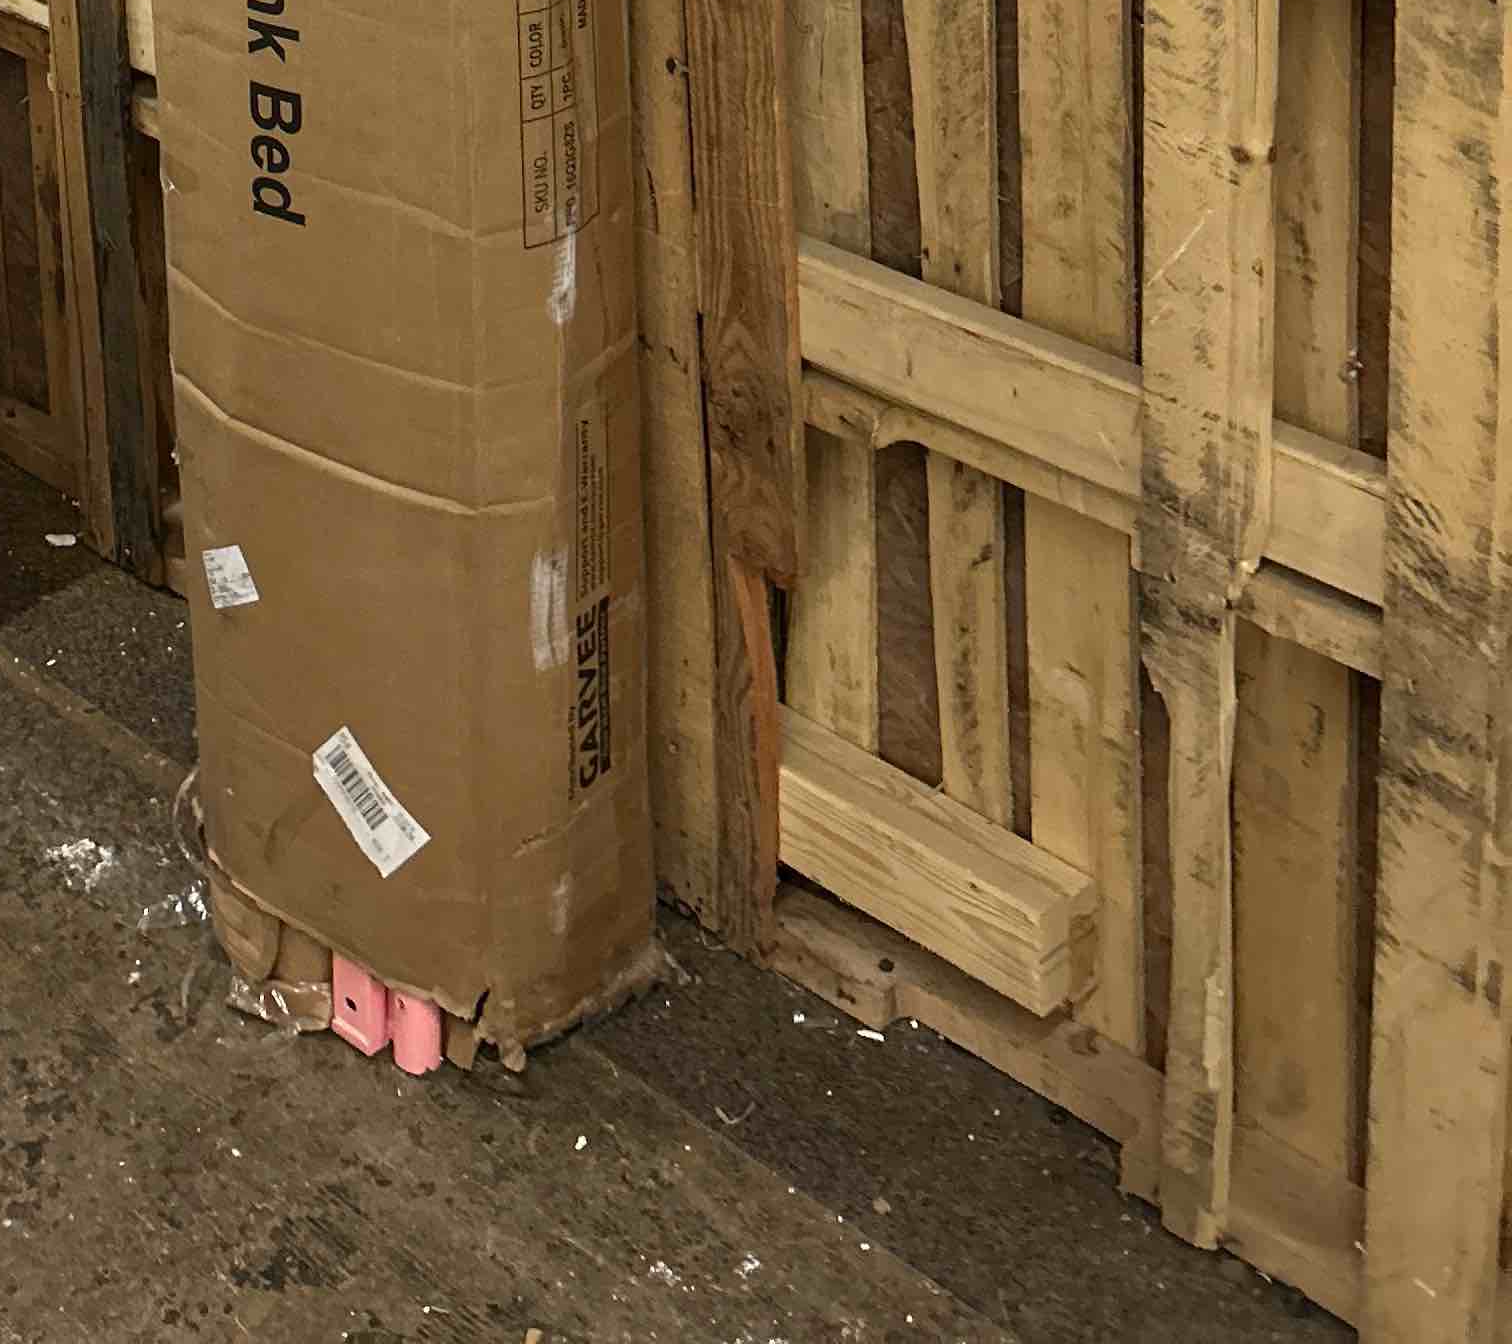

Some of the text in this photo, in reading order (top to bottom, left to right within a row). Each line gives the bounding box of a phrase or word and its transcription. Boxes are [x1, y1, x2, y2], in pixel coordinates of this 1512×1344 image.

[528, 22, 543, 68] COLOR
[530, 84, 545, 110] QTY
[248, 80, 308, 227] Bed
[533, 182, 549, 213] SKU
[576, 609, 600, 789] GARVEE
